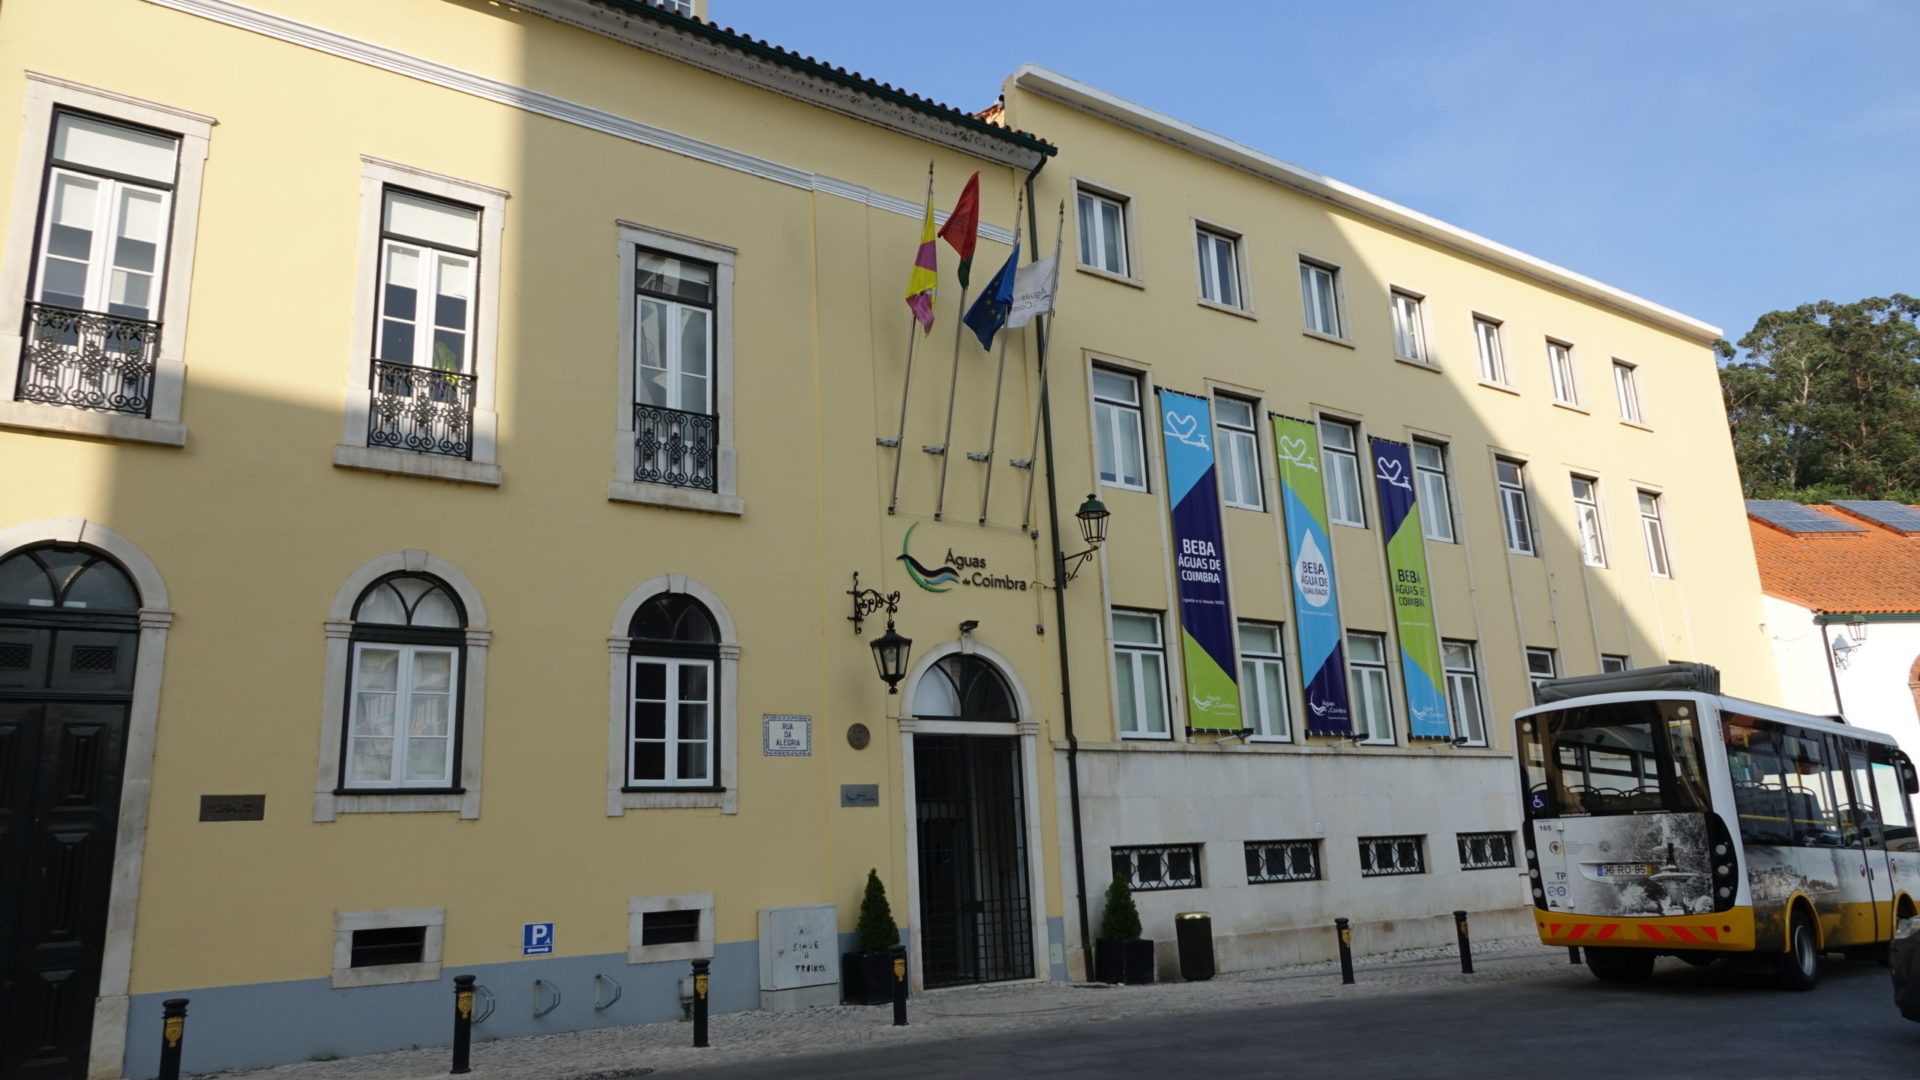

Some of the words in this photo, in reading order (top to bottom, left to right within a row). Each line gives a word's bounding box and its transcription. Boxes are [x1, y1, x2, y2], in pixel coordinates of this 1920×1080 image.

[1182, 538, 1216, 557] BEBA
[944, 547, 986, 570] Águas
[1178, 552, 1208, 570] ÁGUAS
[1209, 559, 1222, 571] DE
[1302, 561, 1325, 576] BEBA
[1397, 568, 1421, 584] BEBA
[962, 578, 971, 586] de
[971, 572, 1027, 591] Coimbra
[1181, 570, 1220, 583] COIMBRA
[1318, 577, 1329, 588] DE
[782, 722, 794, 730] RUA
[784, 730, 792, 738] DA
[1555, 871, 1567, 880] TP
[1604, 865, 1615, 875] 36
[1617, 864, 1631, 874] RO
[532, 924, 548, 946] P
